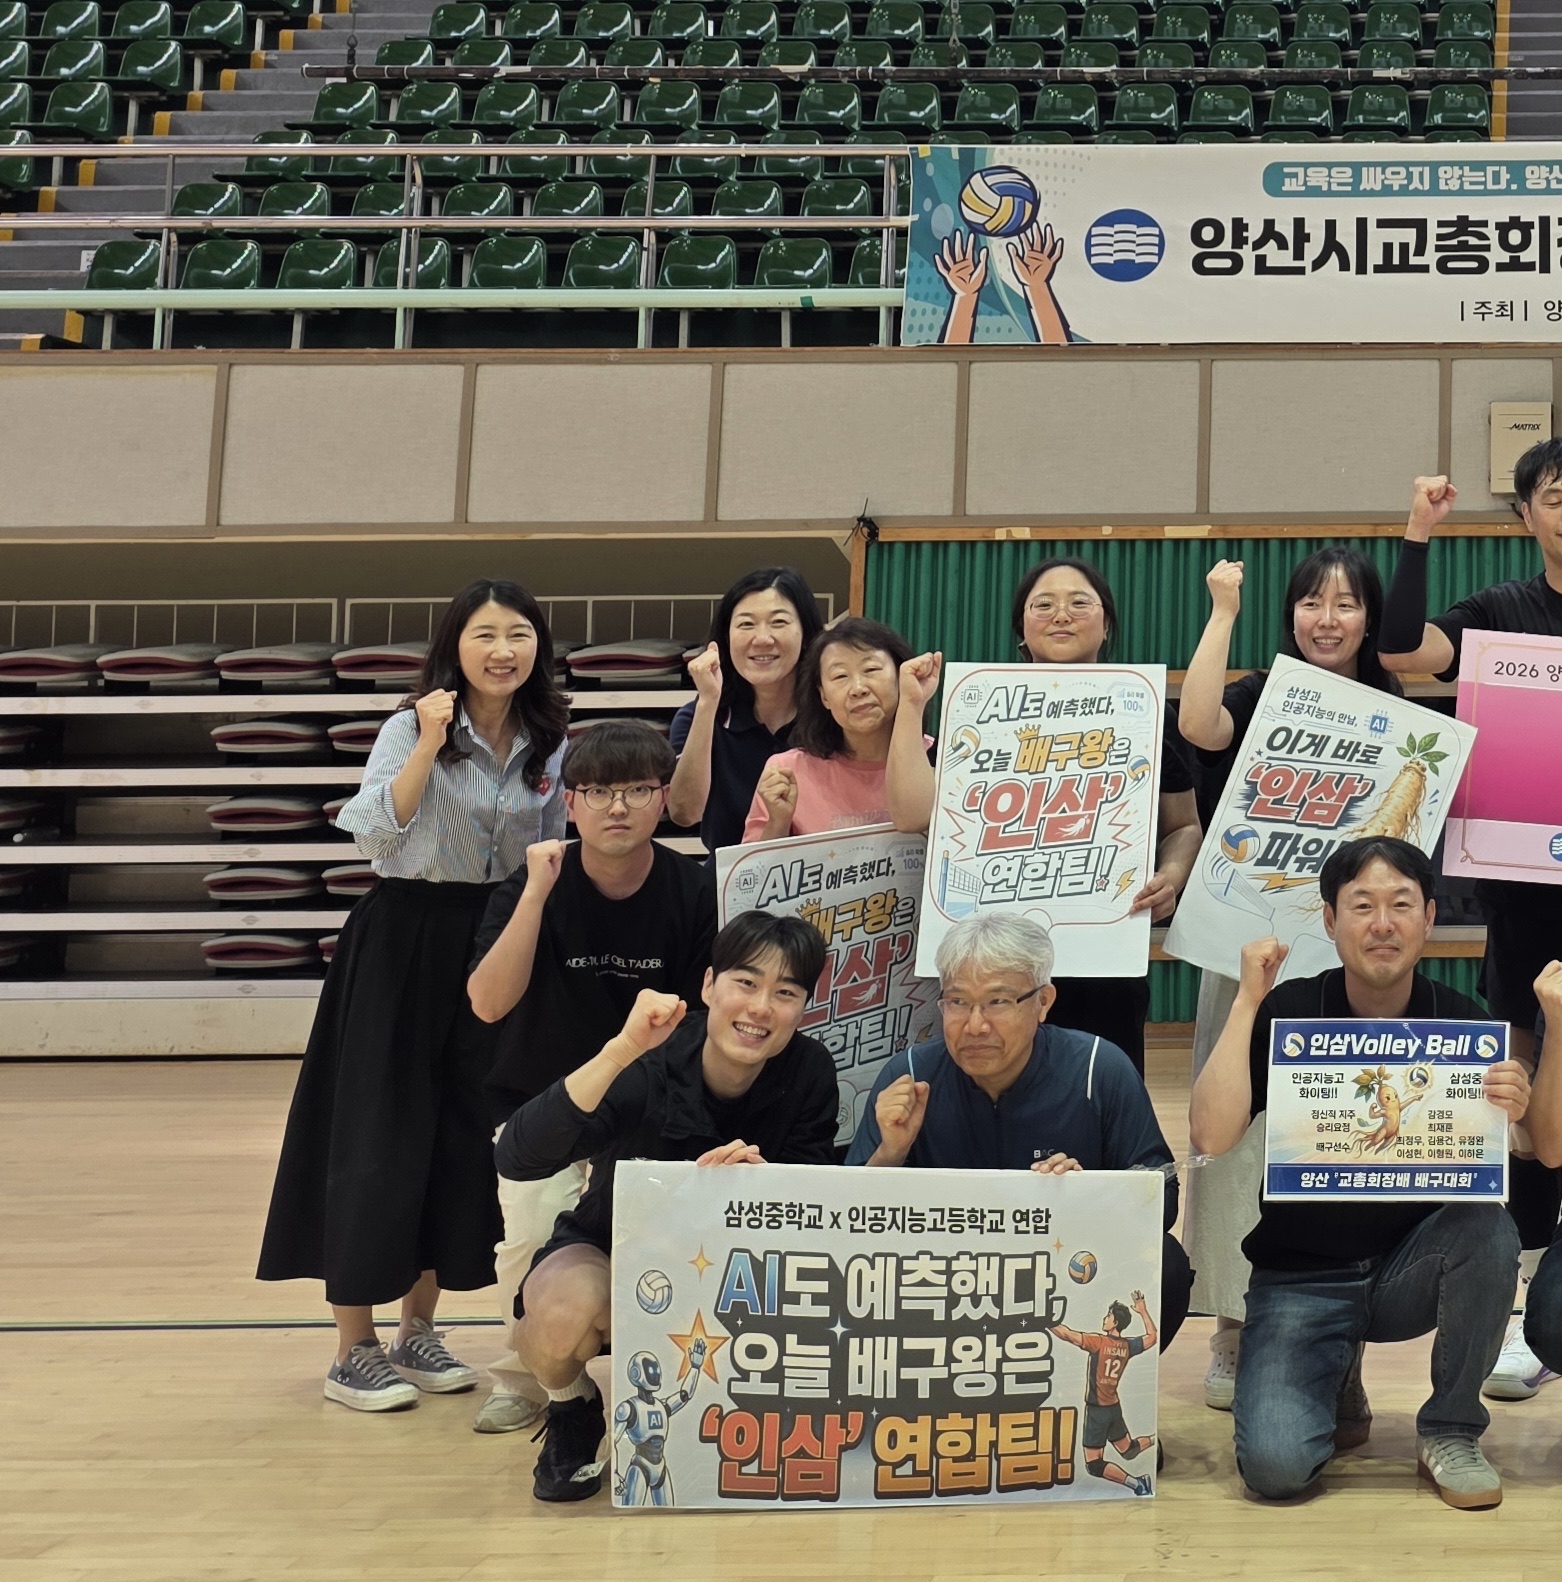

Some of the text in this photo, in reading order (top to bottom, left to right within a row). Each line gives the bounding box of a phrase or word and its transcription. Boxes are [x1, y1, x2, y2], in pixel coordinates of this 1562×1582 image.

[1281, 166, 1353, 191] 교육은
[1360, 166, 1430, 191] 싸우지
[1437, 165, 1518, 191] 않는다.
[1493, 661, 1539, 679] 2026
[966, 692, 977, 701] AI
[976, 684, 1116, 725] AI도 예측했다,
[1286, 686, 1322, 703] 삼성과
[1281, 700, 1337, 721] 인공지능의
[1369, 719, 1386, 731] AI
[970, 727, 1132, 774] 오늘 배구왕은
[1265, 725, 1384, 766] 이게 바로
[1253, 831, 1351, 874] 파워
[742, 878, 753, 887] AI
[755, 856, 897, 910] AI도 예측했다,
[979, 845, 1118, 905] 연합팀!
[800, 1004, 914, 1072] 합팀!
[1309, 1033, 1471, 1058] 인삼Volley Ball
[1292, 1072, 1345, 1084] 인공지능고
[1450, 1072, 1483, 1085] 삼성중
[1338, 1109, 1356, 1120] 지주
[1458, 1148, 1485, 1159] 이하은
[1300, 1172, 1330, 1187] 양산
[723, 1200, 824, 1232] 삼성중학교
[846, 1205, 1006, 1236] 인공지능고등학교
[1011, 1207, 1052, 1236] 연합
[717, 1250, 1067, 1323] AI도 예측했다,
[730, 1330, 1054, 1400] 오늘 배구왕은
[1104, 1358, 1122, 1379] 12
[650, 1413, 662, 1427] AI
[873, 1407, 1078, 1496] 연합팀!
